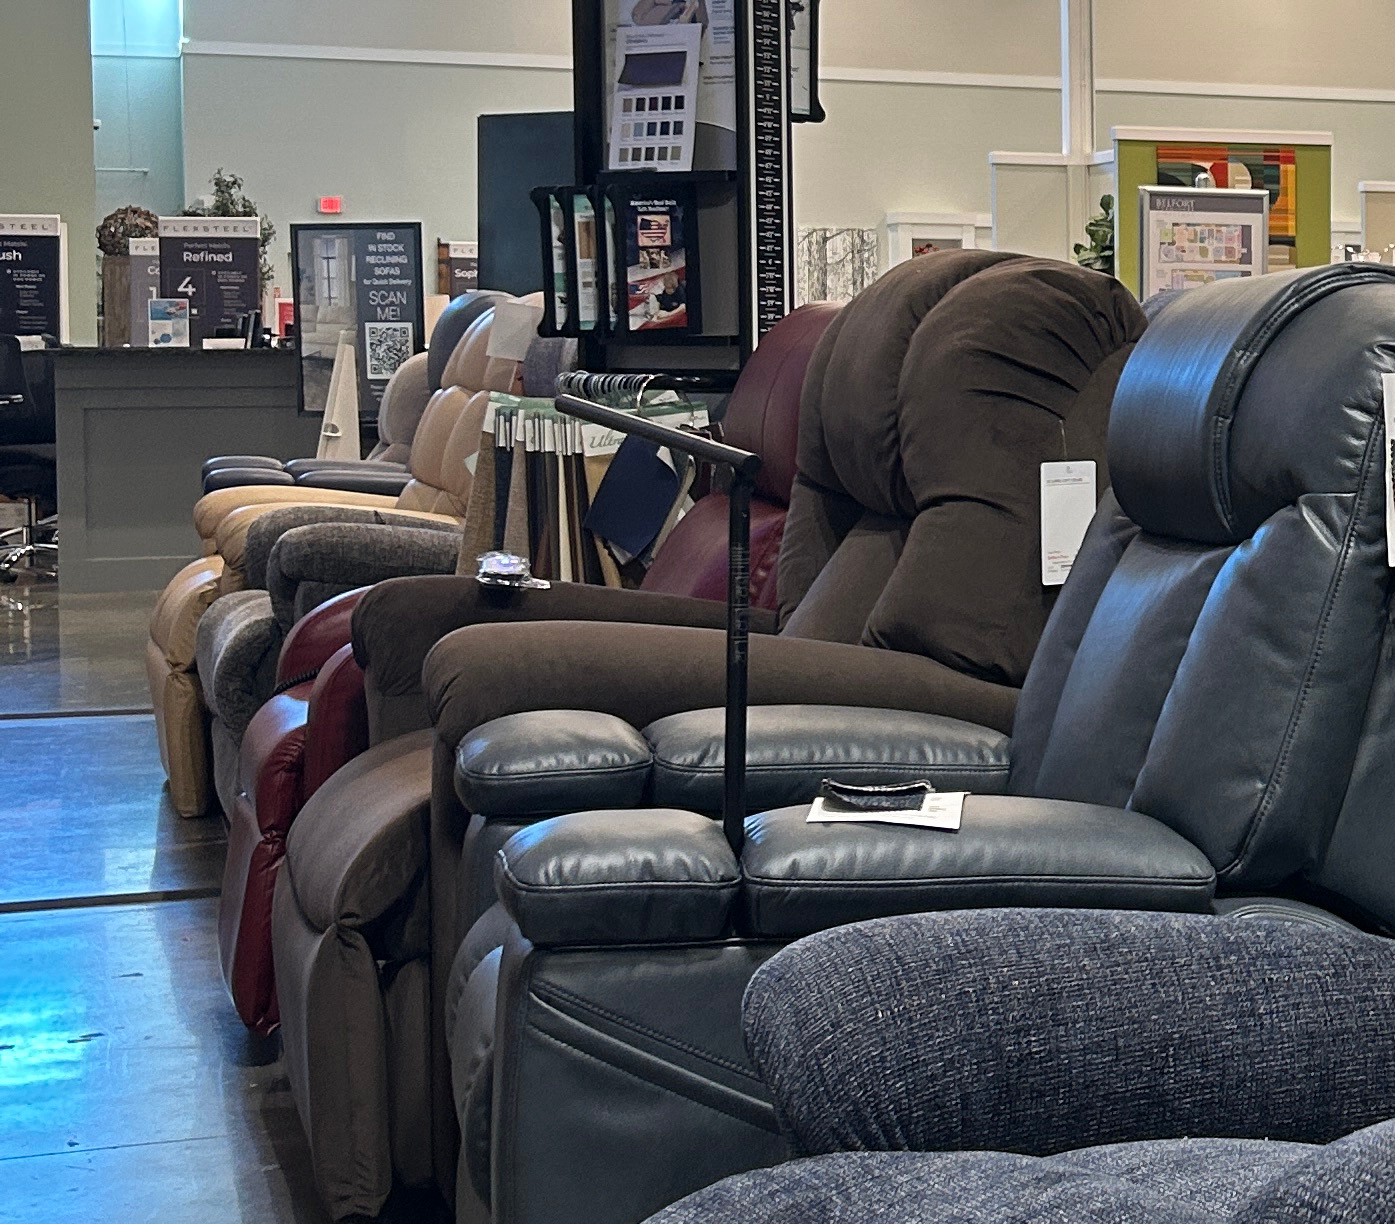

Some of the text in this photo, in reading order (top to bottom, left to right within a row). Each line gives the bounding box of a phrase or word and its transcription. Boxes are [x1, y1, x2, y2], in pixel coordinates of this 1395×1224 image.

[376, 231, 396, 240] FIND
[367, 243, 404, 252] IN STOCK
[183, 251, 233, 262] Refined
[365, 255, 408, 263] RECLINING
[374, 266, 400, 275] SOFAS
[177, 276, 196, 296] 4
[368, 290, 407, 305] SCAN
[376, 306, 400, 320] ME!
